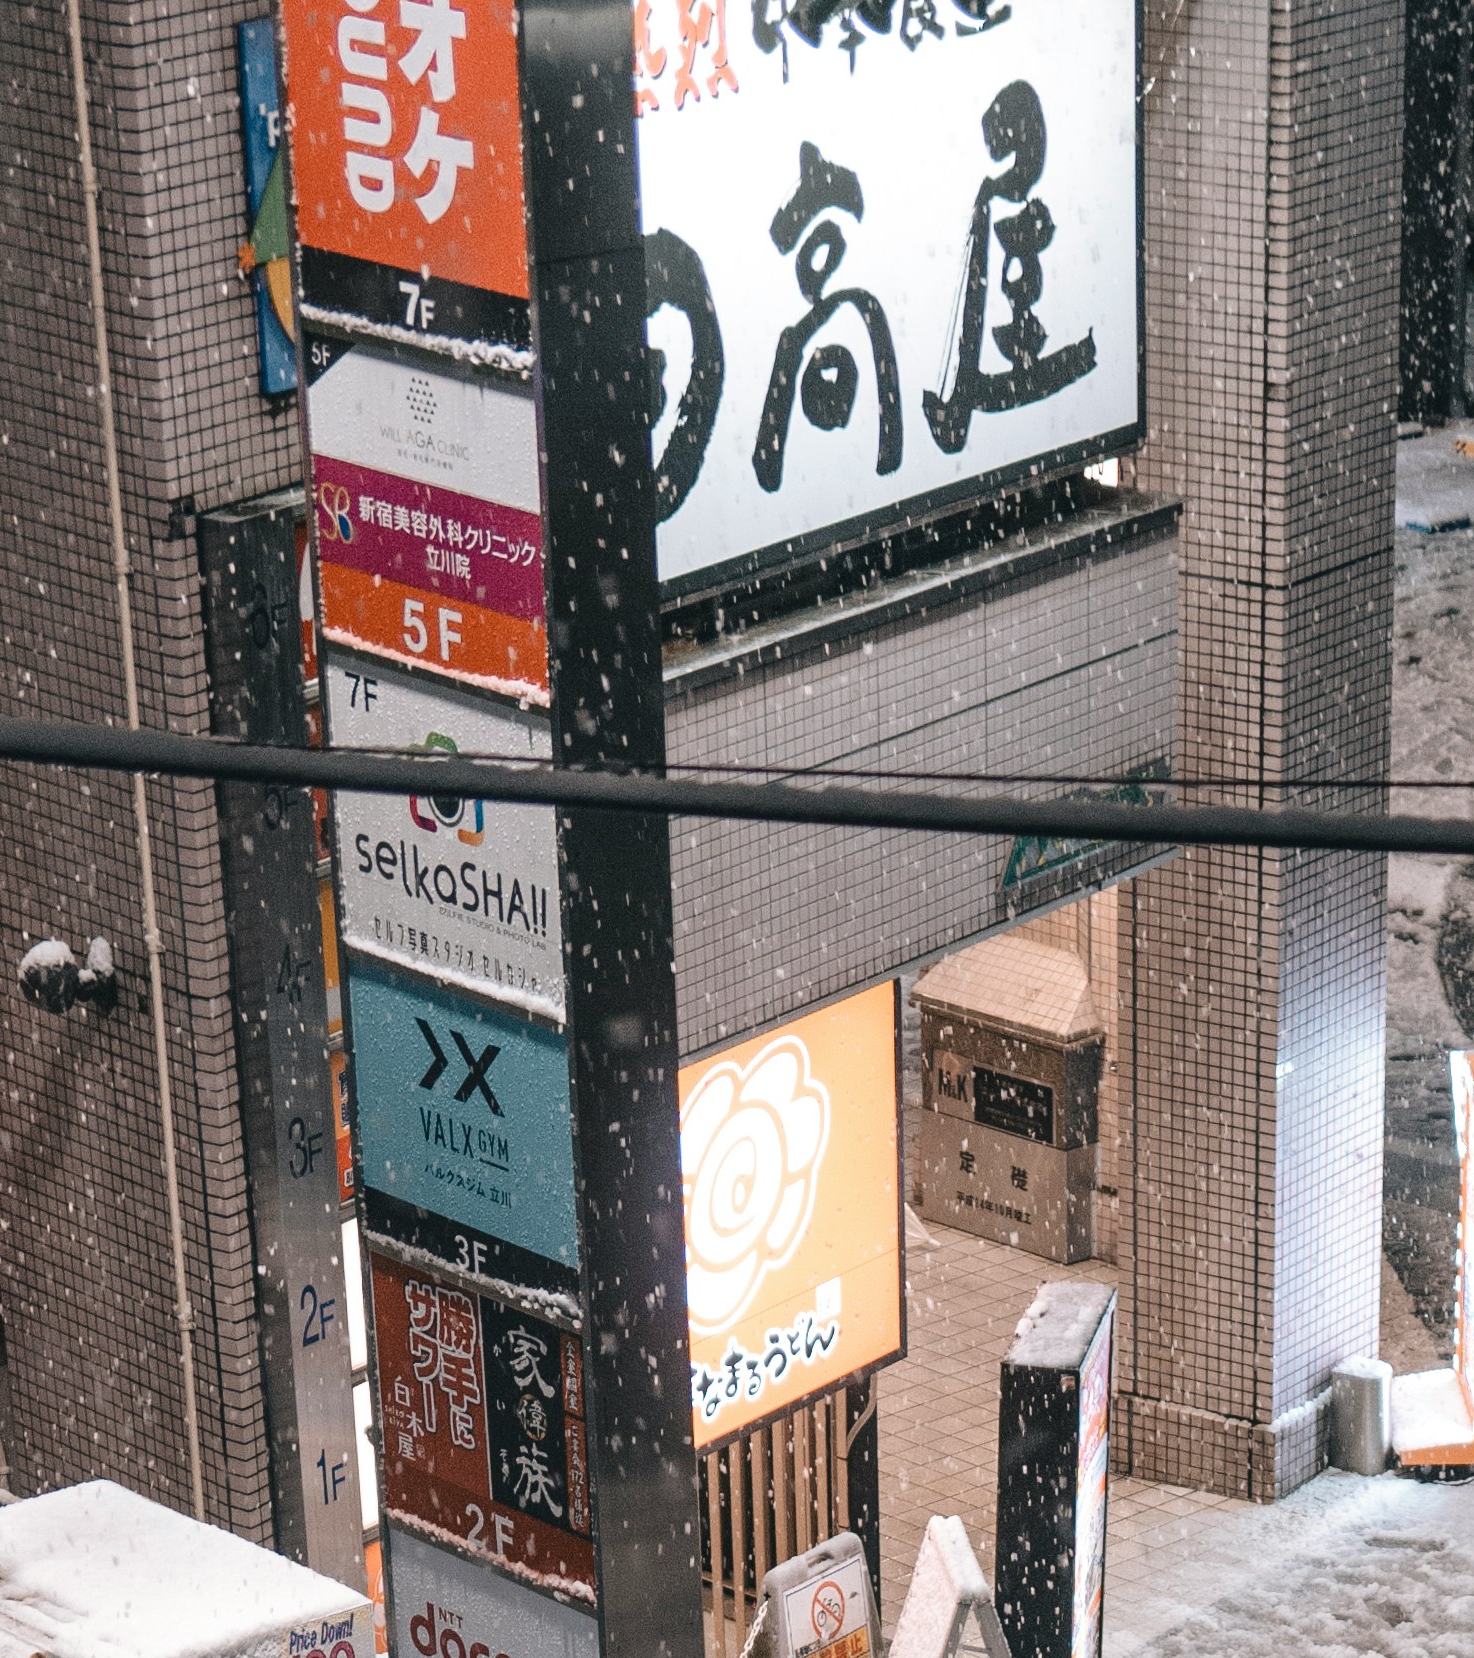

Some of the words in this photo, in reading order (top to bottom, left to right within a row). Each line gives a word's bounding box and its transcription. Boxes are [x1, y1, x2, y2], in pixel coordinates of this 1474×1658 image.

[399, 281, 434, 329] 7F
[312, 343, 330, 366] 5F
[380, 425, 401, 443] WILL
[407, 430, 435, 449] AGA
[437, 439, 470, 461] CLINIC
[358, 494, 536, 567] 新宿美容外科クリニック
[425, 544, 472, 580] 立川院
[402, 598, 463, 661] 5F
[344, 671, 378, 712] 7F
[355, 833, 547, 938] selkaSHA!!
[375, 916, 473, 971] セルフ写真スタジオ
[466, 913, 494, 933] STUDIO
[503, 929, 529, 945] PHOTO
[532, 939, 546, 951] LAB
[289, 1117, 322, 1179] 3F
[420, 1107, 474, 1157] VALX
[478, 1129, 509, 1163] GYM
[425, 1163, 486, 1197] バルクスジム
[489, 1185, 512, 1209] 立川
[455, 1234, 488, 1273] 3F
[301, 1284, 335, 1347] 2F
[405, 1279, 443, 1433] サワー
[436, 1287, 480, 1450] 勝手に
[691, 1318, 836, 1418] なまるうどん
[394, 1375, 425, 1461] 白木屋
[317, 1449, 346, 1505] 1F
[465, 1502, 516, 1555] 2F
[290, 1628, 317, 1655] Price
[321, 1613, 354, 1645] Down!
[438, 1607, 463, 1630] NTT
